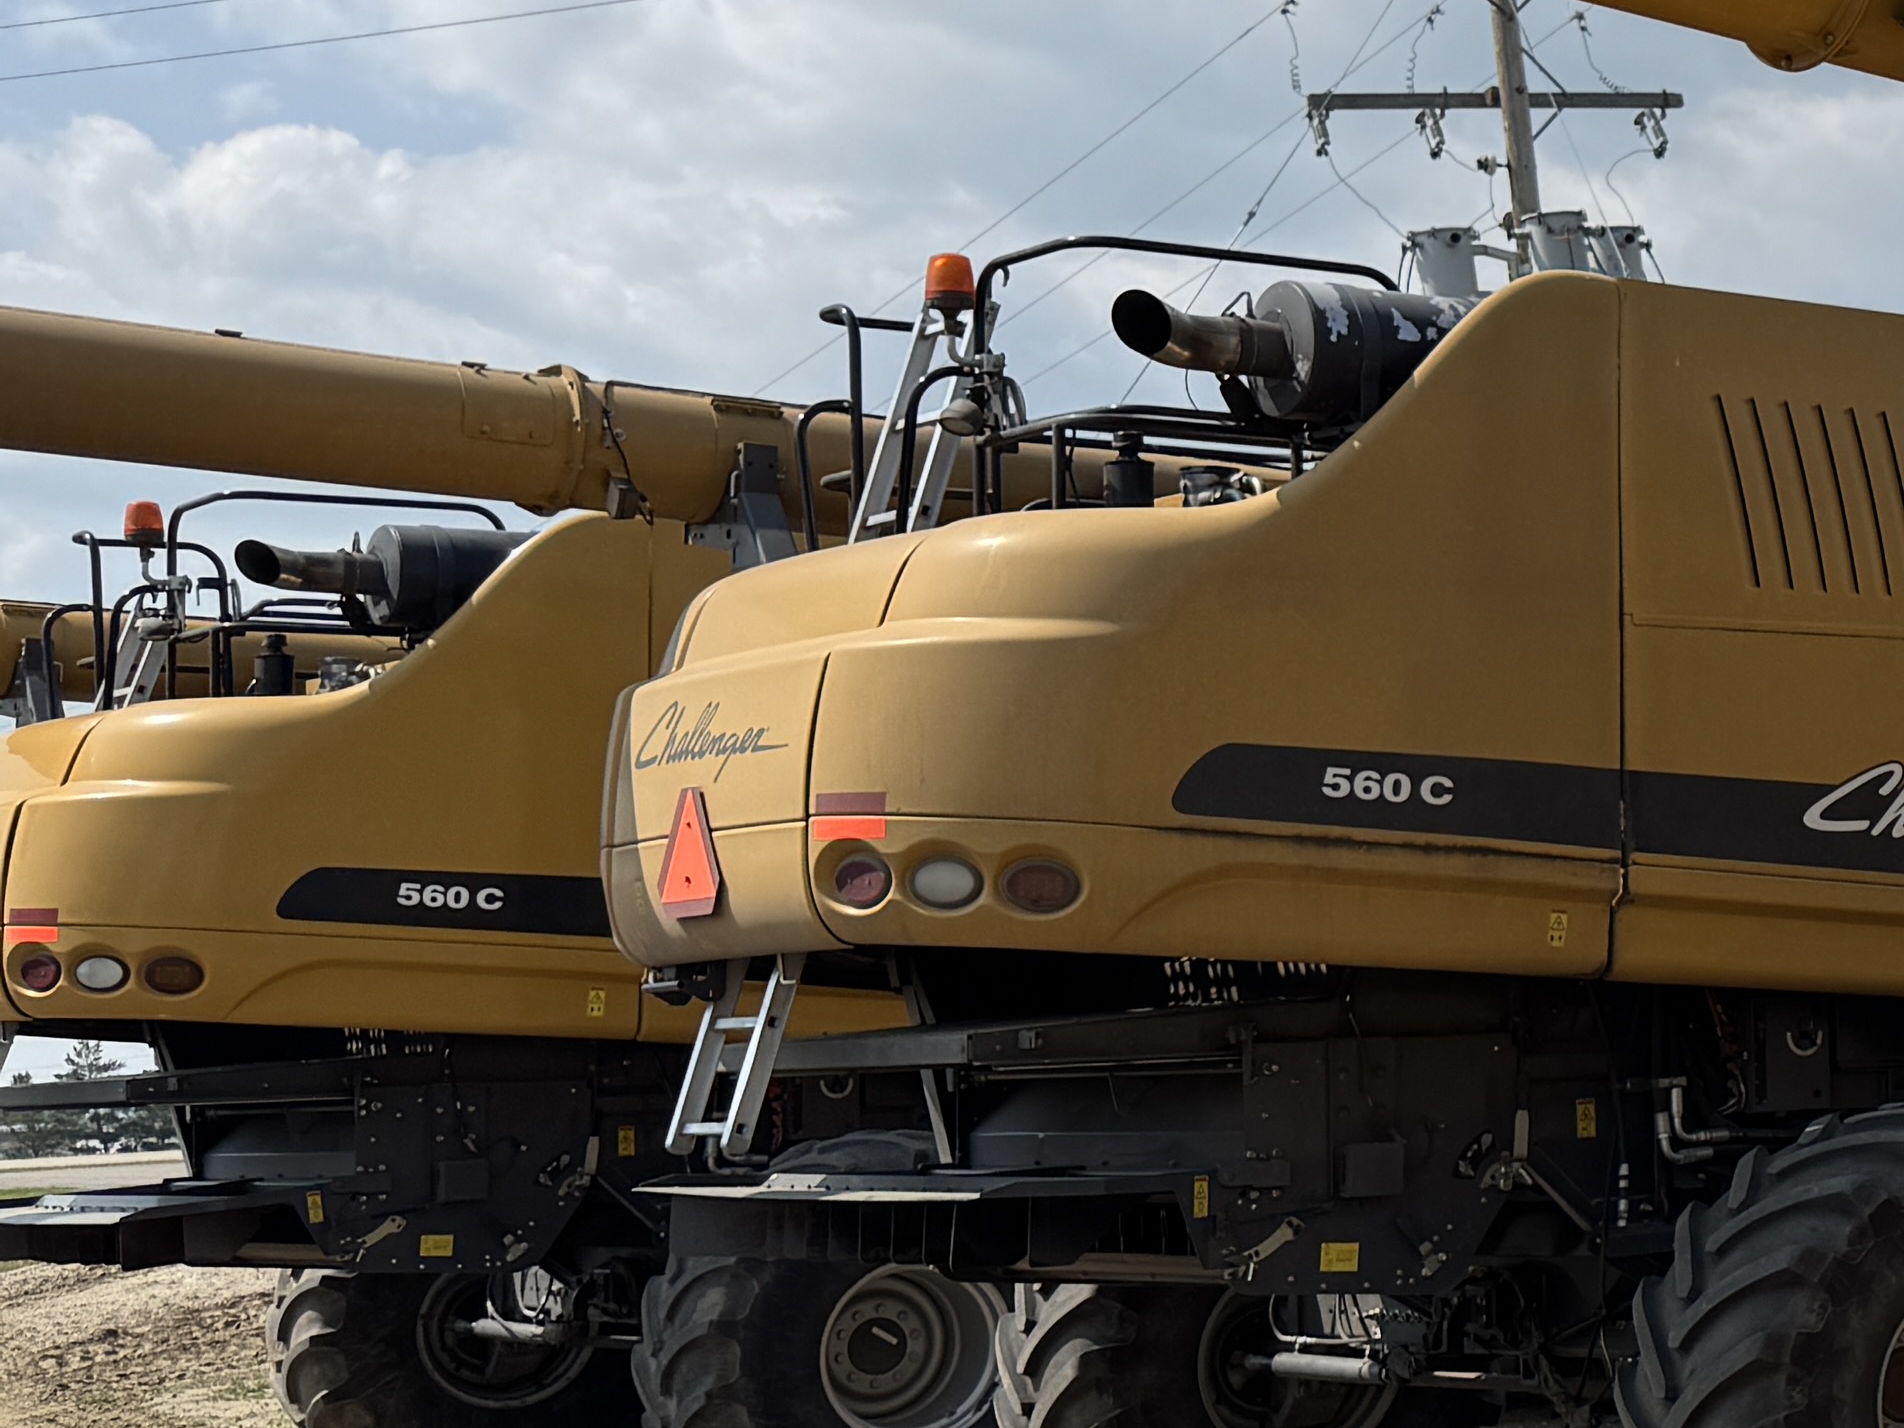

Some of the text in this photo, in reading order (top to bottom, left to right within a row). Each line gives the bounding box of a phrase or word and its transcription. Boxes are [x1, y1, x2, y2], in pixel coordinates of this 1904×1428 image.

[633, 700, 790, 784] Challenger
[1320, 765, 1456, 807] 560 C
[396, 882, 506, 912] 560 C
